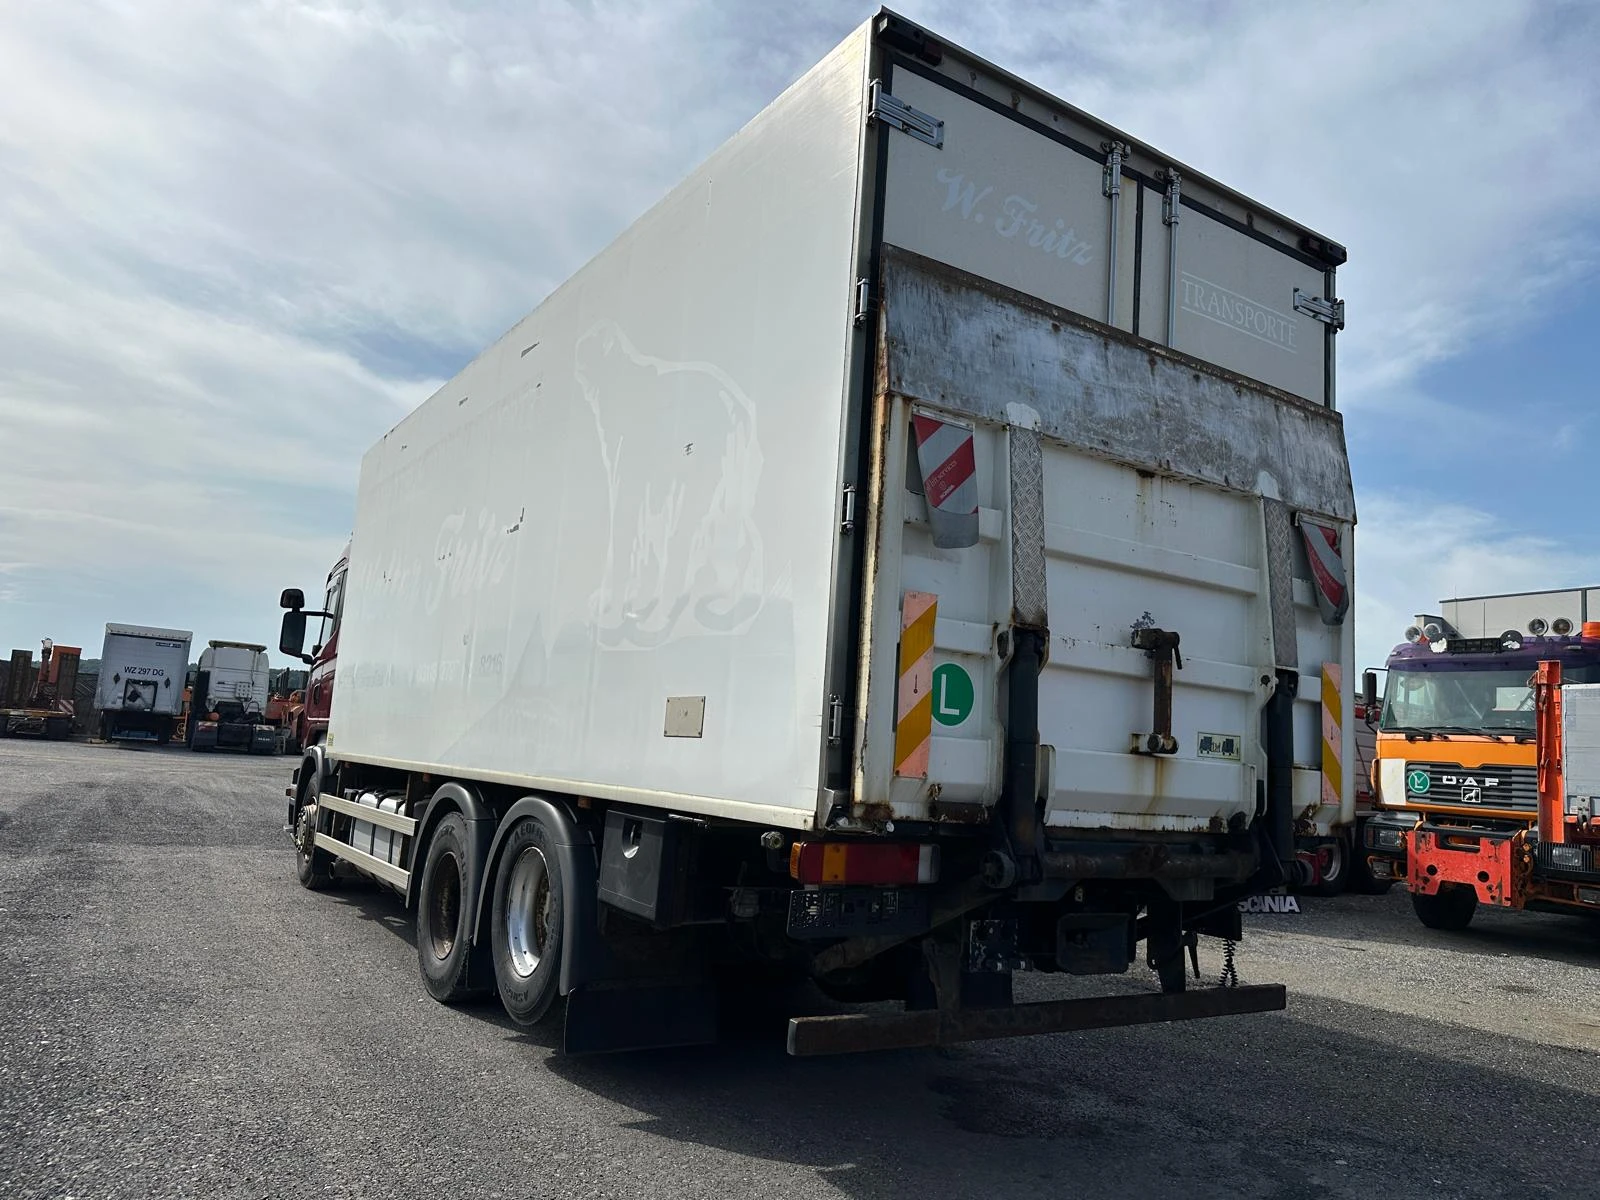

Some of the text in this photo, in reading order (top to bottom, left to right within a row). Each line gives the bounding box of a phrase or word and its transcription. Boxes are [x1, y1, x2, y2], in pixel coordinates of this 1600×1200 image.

[936, 166, 1094, 267] W. Fritz
[1181, 278, 1298, 347] TRANSPORTE
[124, 666, 137, 674] WZ
[138, 667, 151, 675] 297
[939, 673, 960, 716] L
